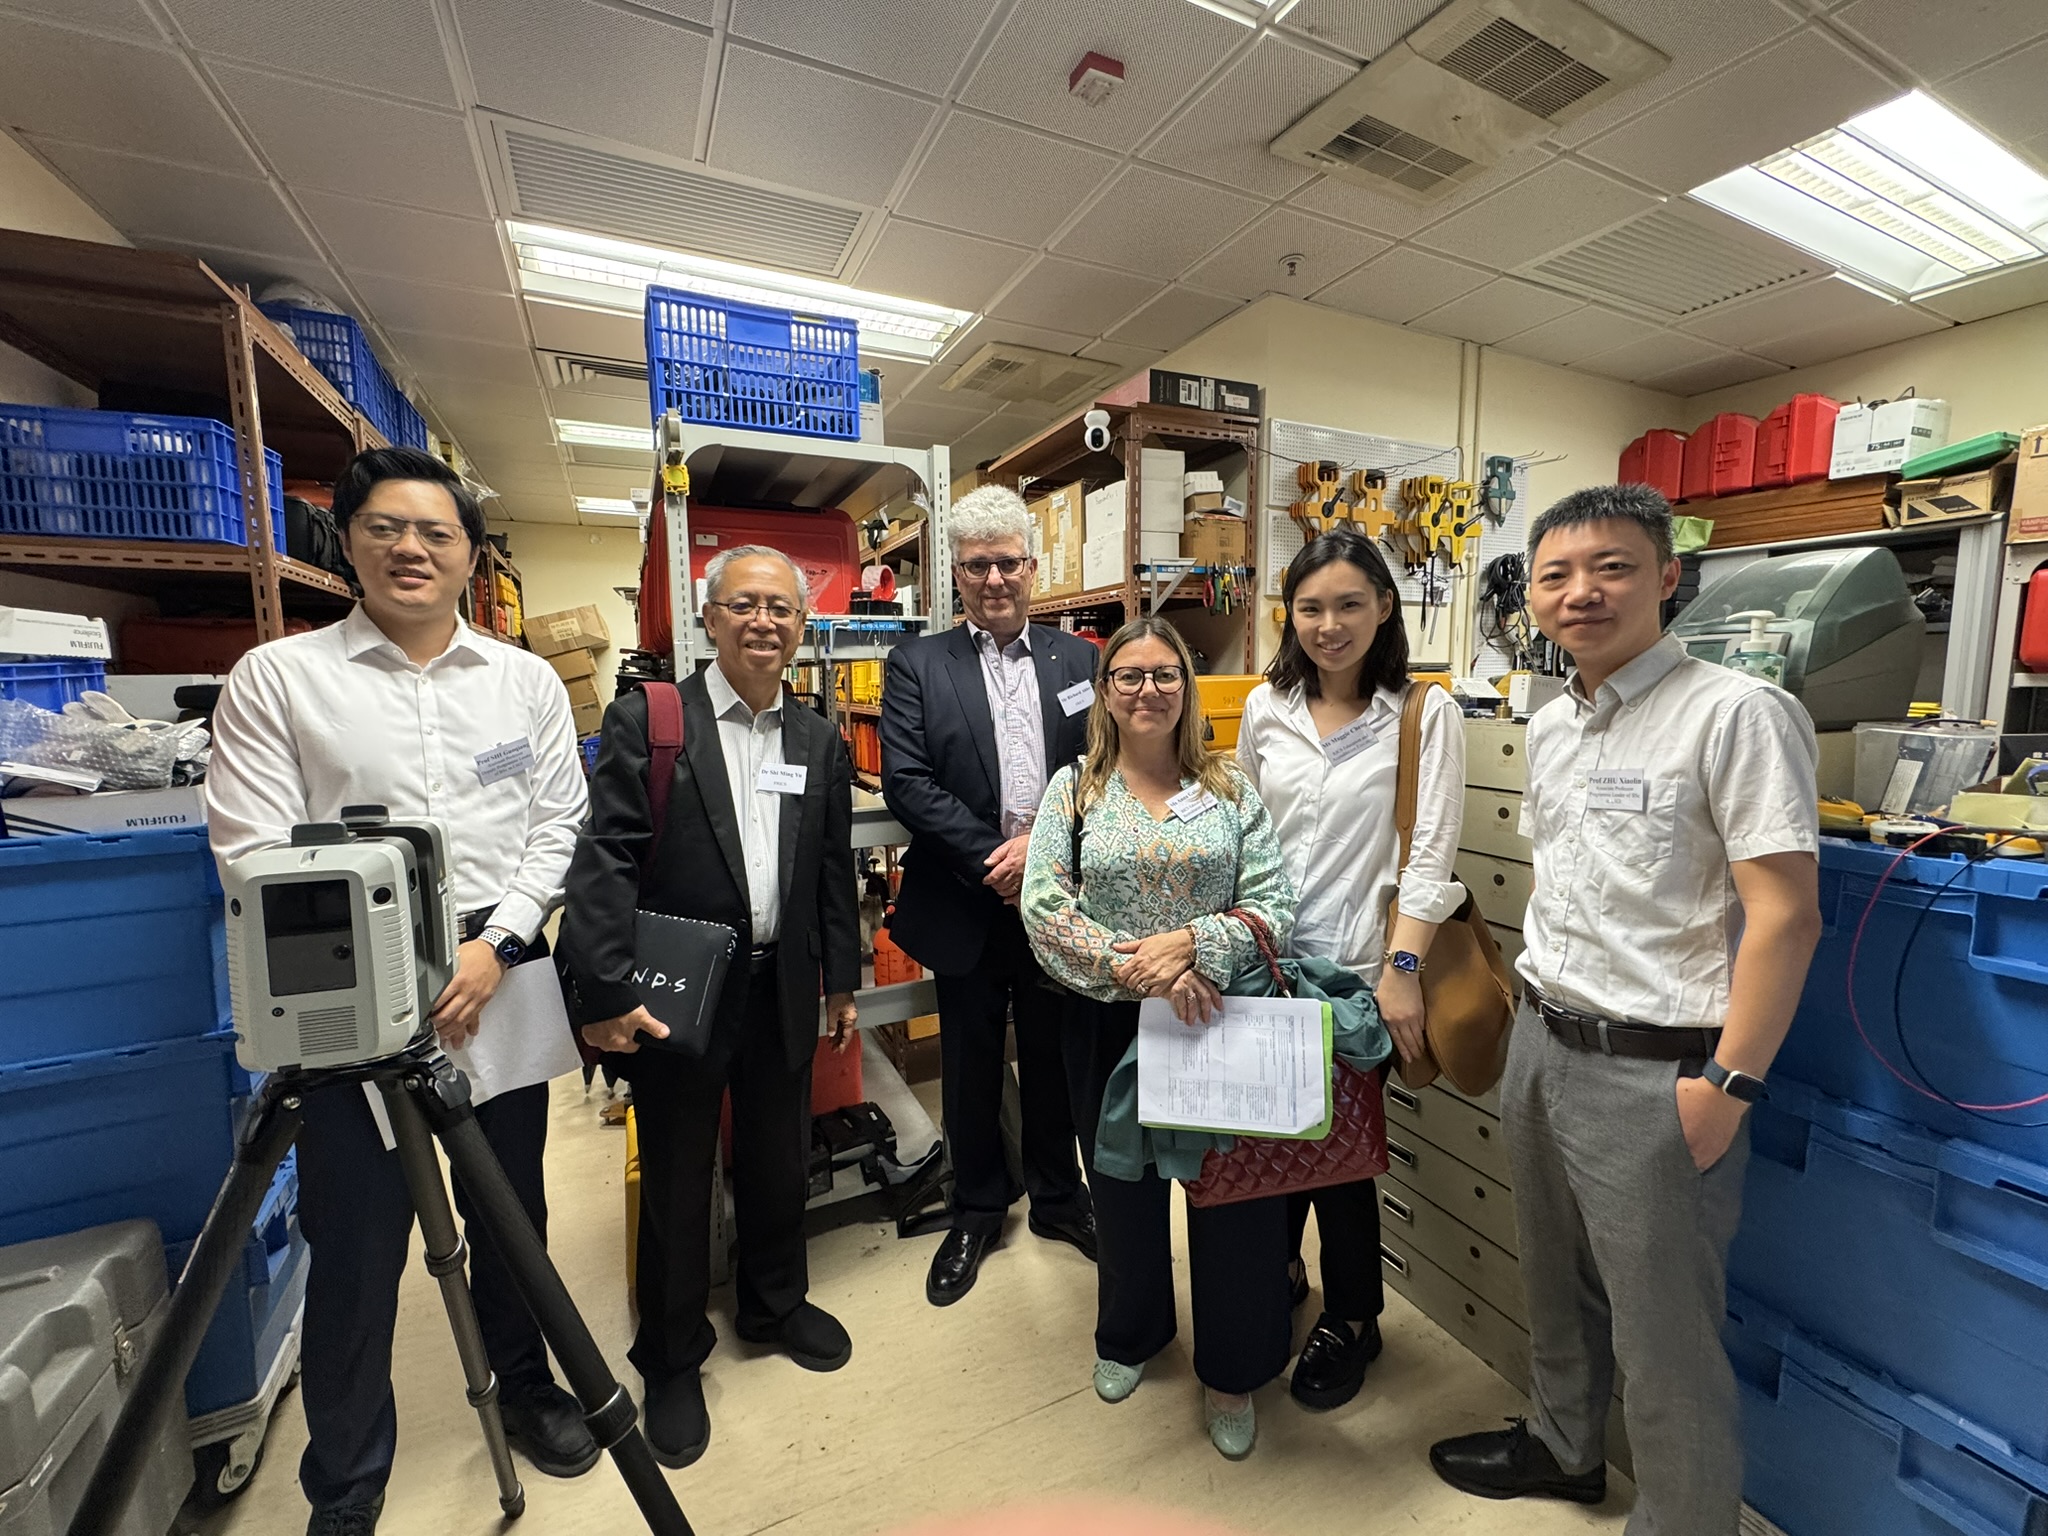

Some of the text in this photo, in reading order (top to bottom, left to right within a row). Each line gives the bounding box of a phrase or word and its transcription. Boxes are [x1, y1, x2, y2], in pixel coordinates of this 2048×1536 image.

[73, 629, 102, 638] Excellence
[69, 640, 104, 649] FUJIFILM
[1330, 731, 1350, 743] Maggie
[476, 757, 490, 766] Prof
[125, 814, 187, 827] FUJIFILM
